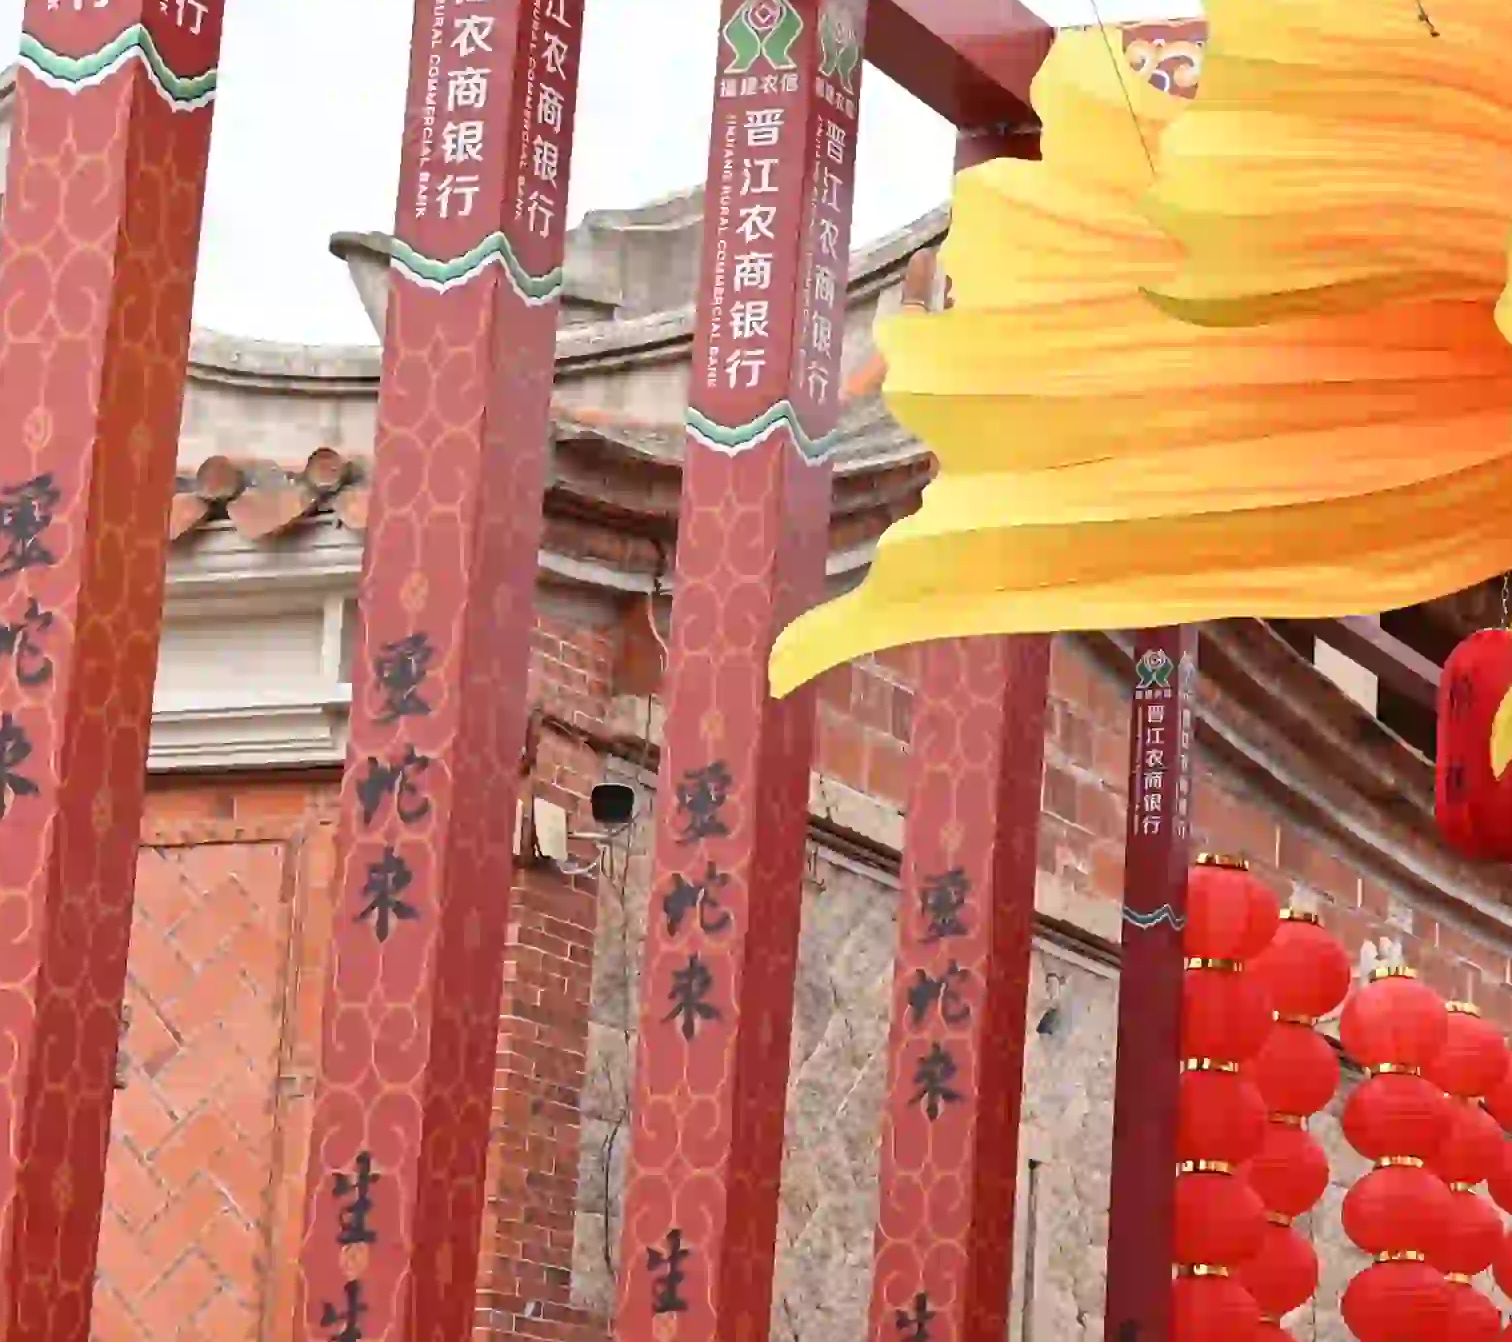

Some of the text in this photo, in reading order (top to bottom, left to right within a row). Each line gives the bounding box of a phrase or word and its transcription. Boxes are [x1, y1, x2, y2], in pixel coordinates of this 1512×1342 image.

[726, 109, 783, 388] 晋江农商银行
